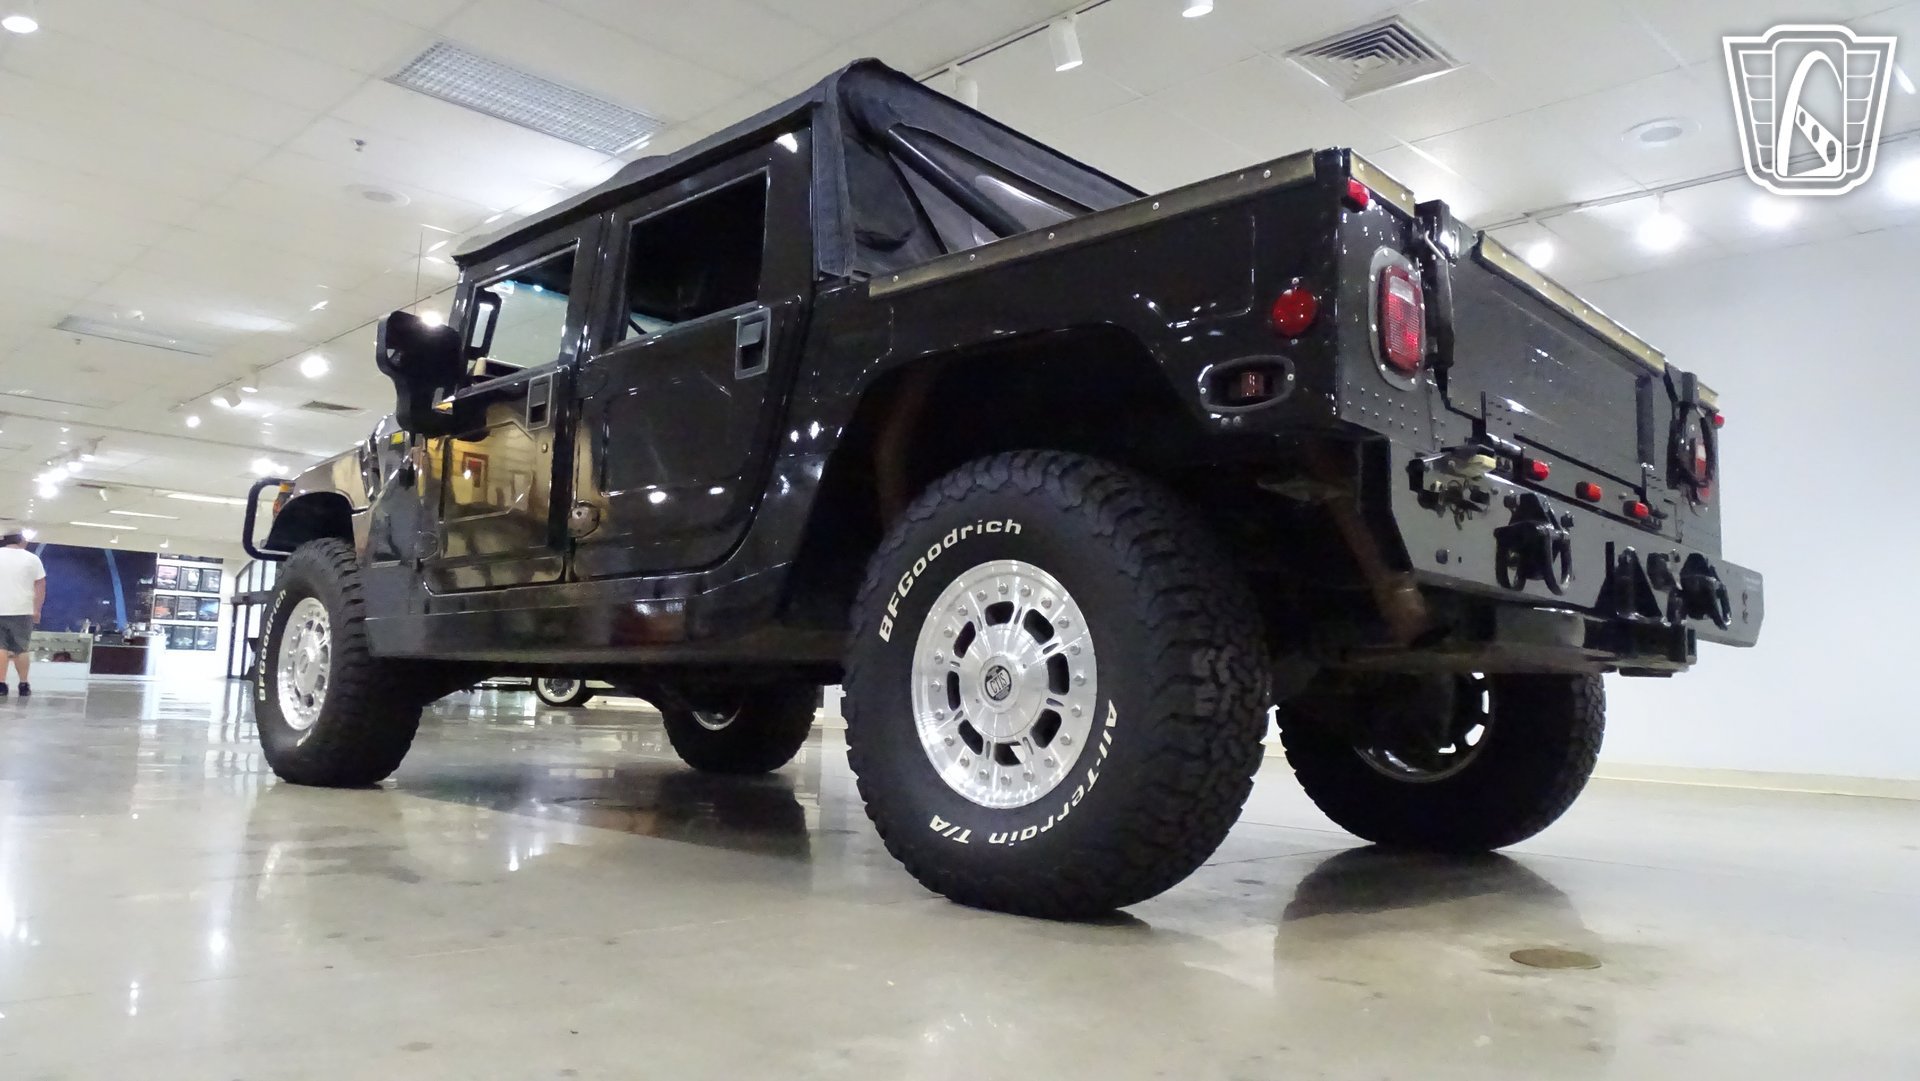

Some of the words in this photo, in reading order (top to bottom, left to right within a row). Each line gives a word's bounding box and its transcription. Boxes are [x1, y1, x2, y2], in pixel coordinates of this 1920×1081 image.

[879, 519, 1021, 642] BFGoodrich
[259, 589, 286, 700] BFGoodrich
[930, 815, 971, 843] T/A
[989, 700, 1117, 846] All-Terrain
